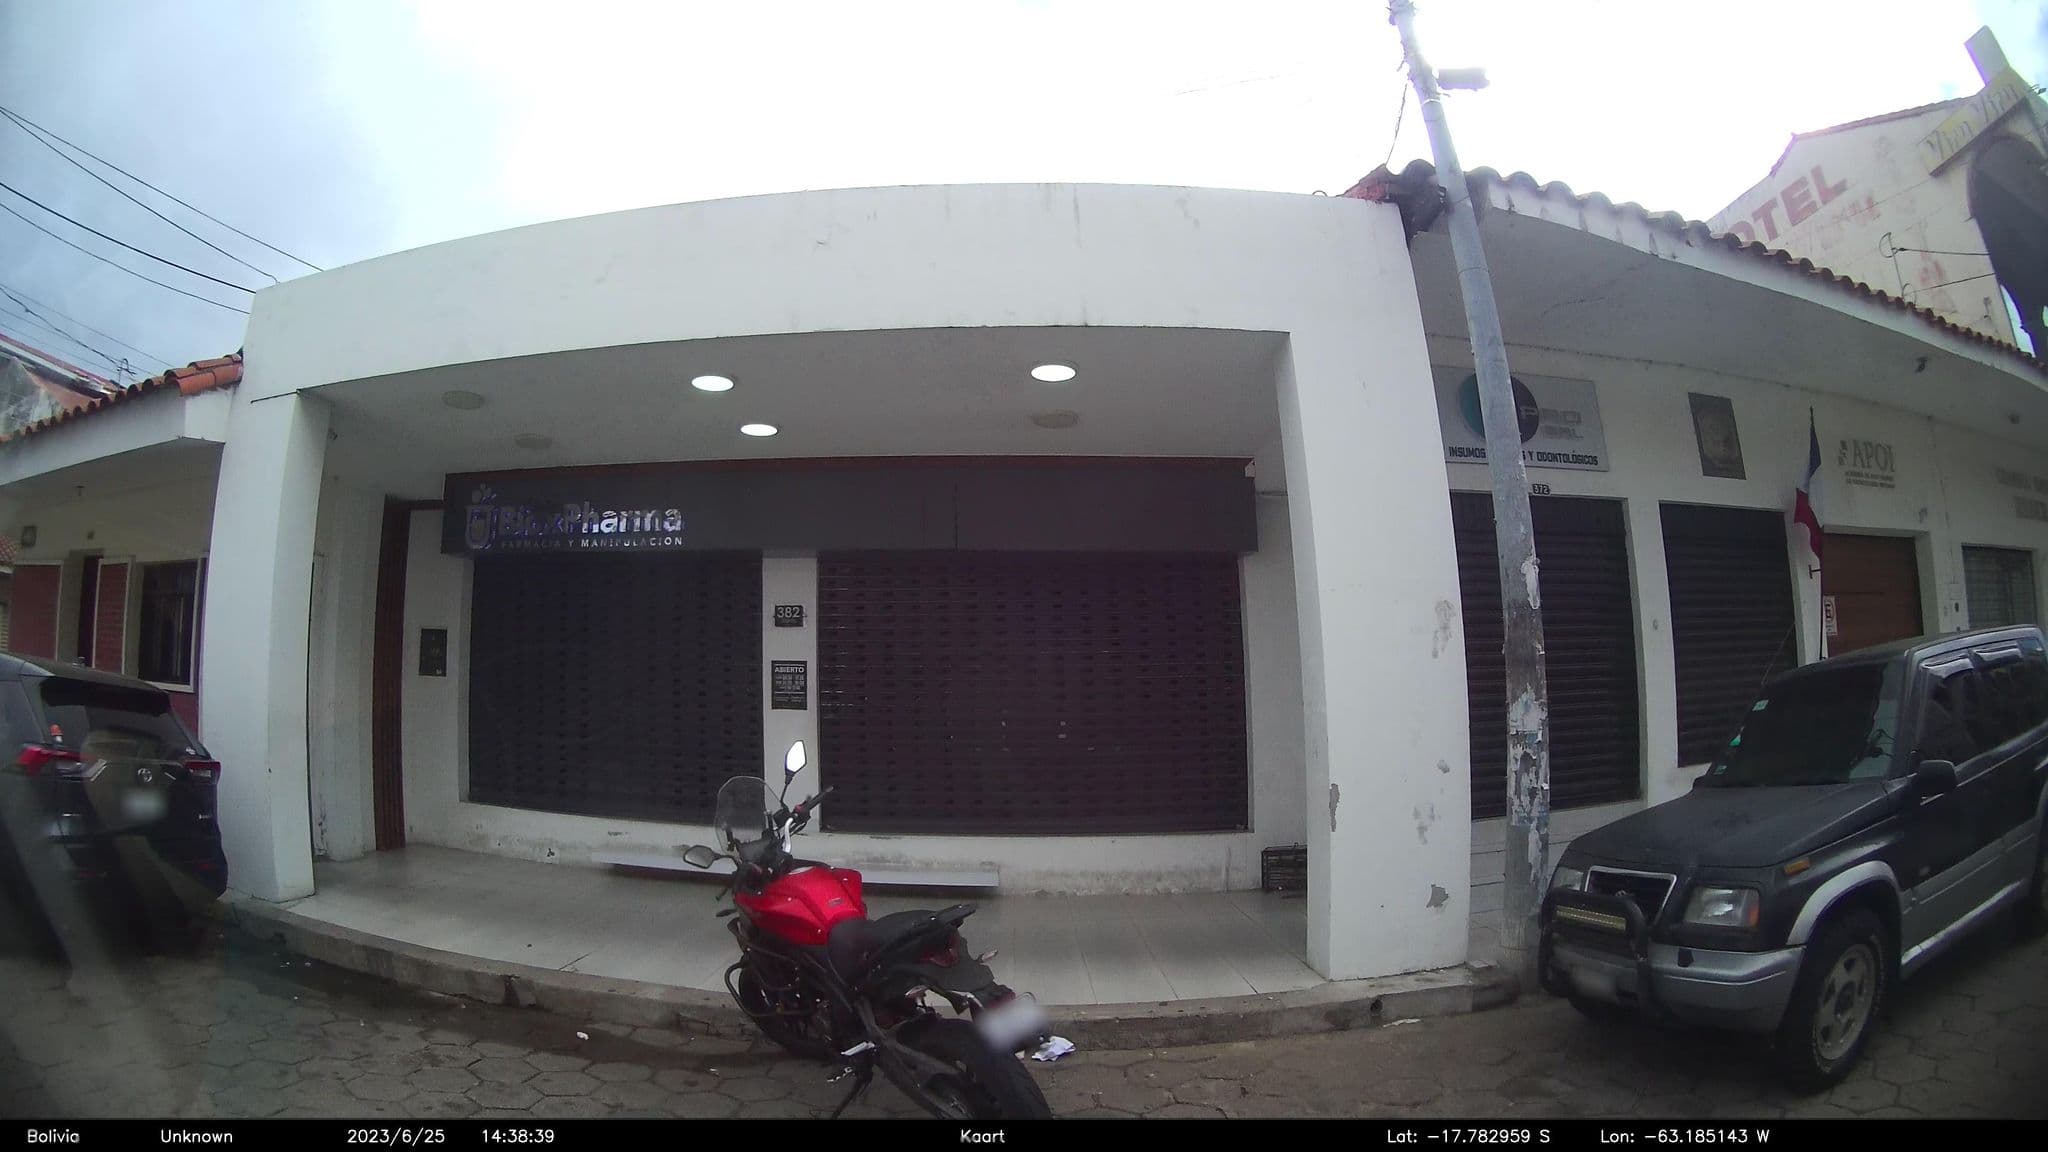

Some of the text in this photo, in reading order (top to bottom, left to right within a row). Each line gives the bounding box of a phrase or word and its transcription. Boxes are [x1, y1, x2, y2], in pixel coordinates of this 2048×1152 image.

[1728, 164, 1848, 246] OTEL
[1449, 446, 1486, 459] INSUMOS
[1529, 451, 1535, 461] Y
[1536, 450, 1598, 466] ODONTOLÓGICOS
[1534, 484, 1549, 494] 372
[568, 539, 575, 548] Y
[776, 606, 801, 619] 382
[774, 666, 805, 674] ABIERTO
